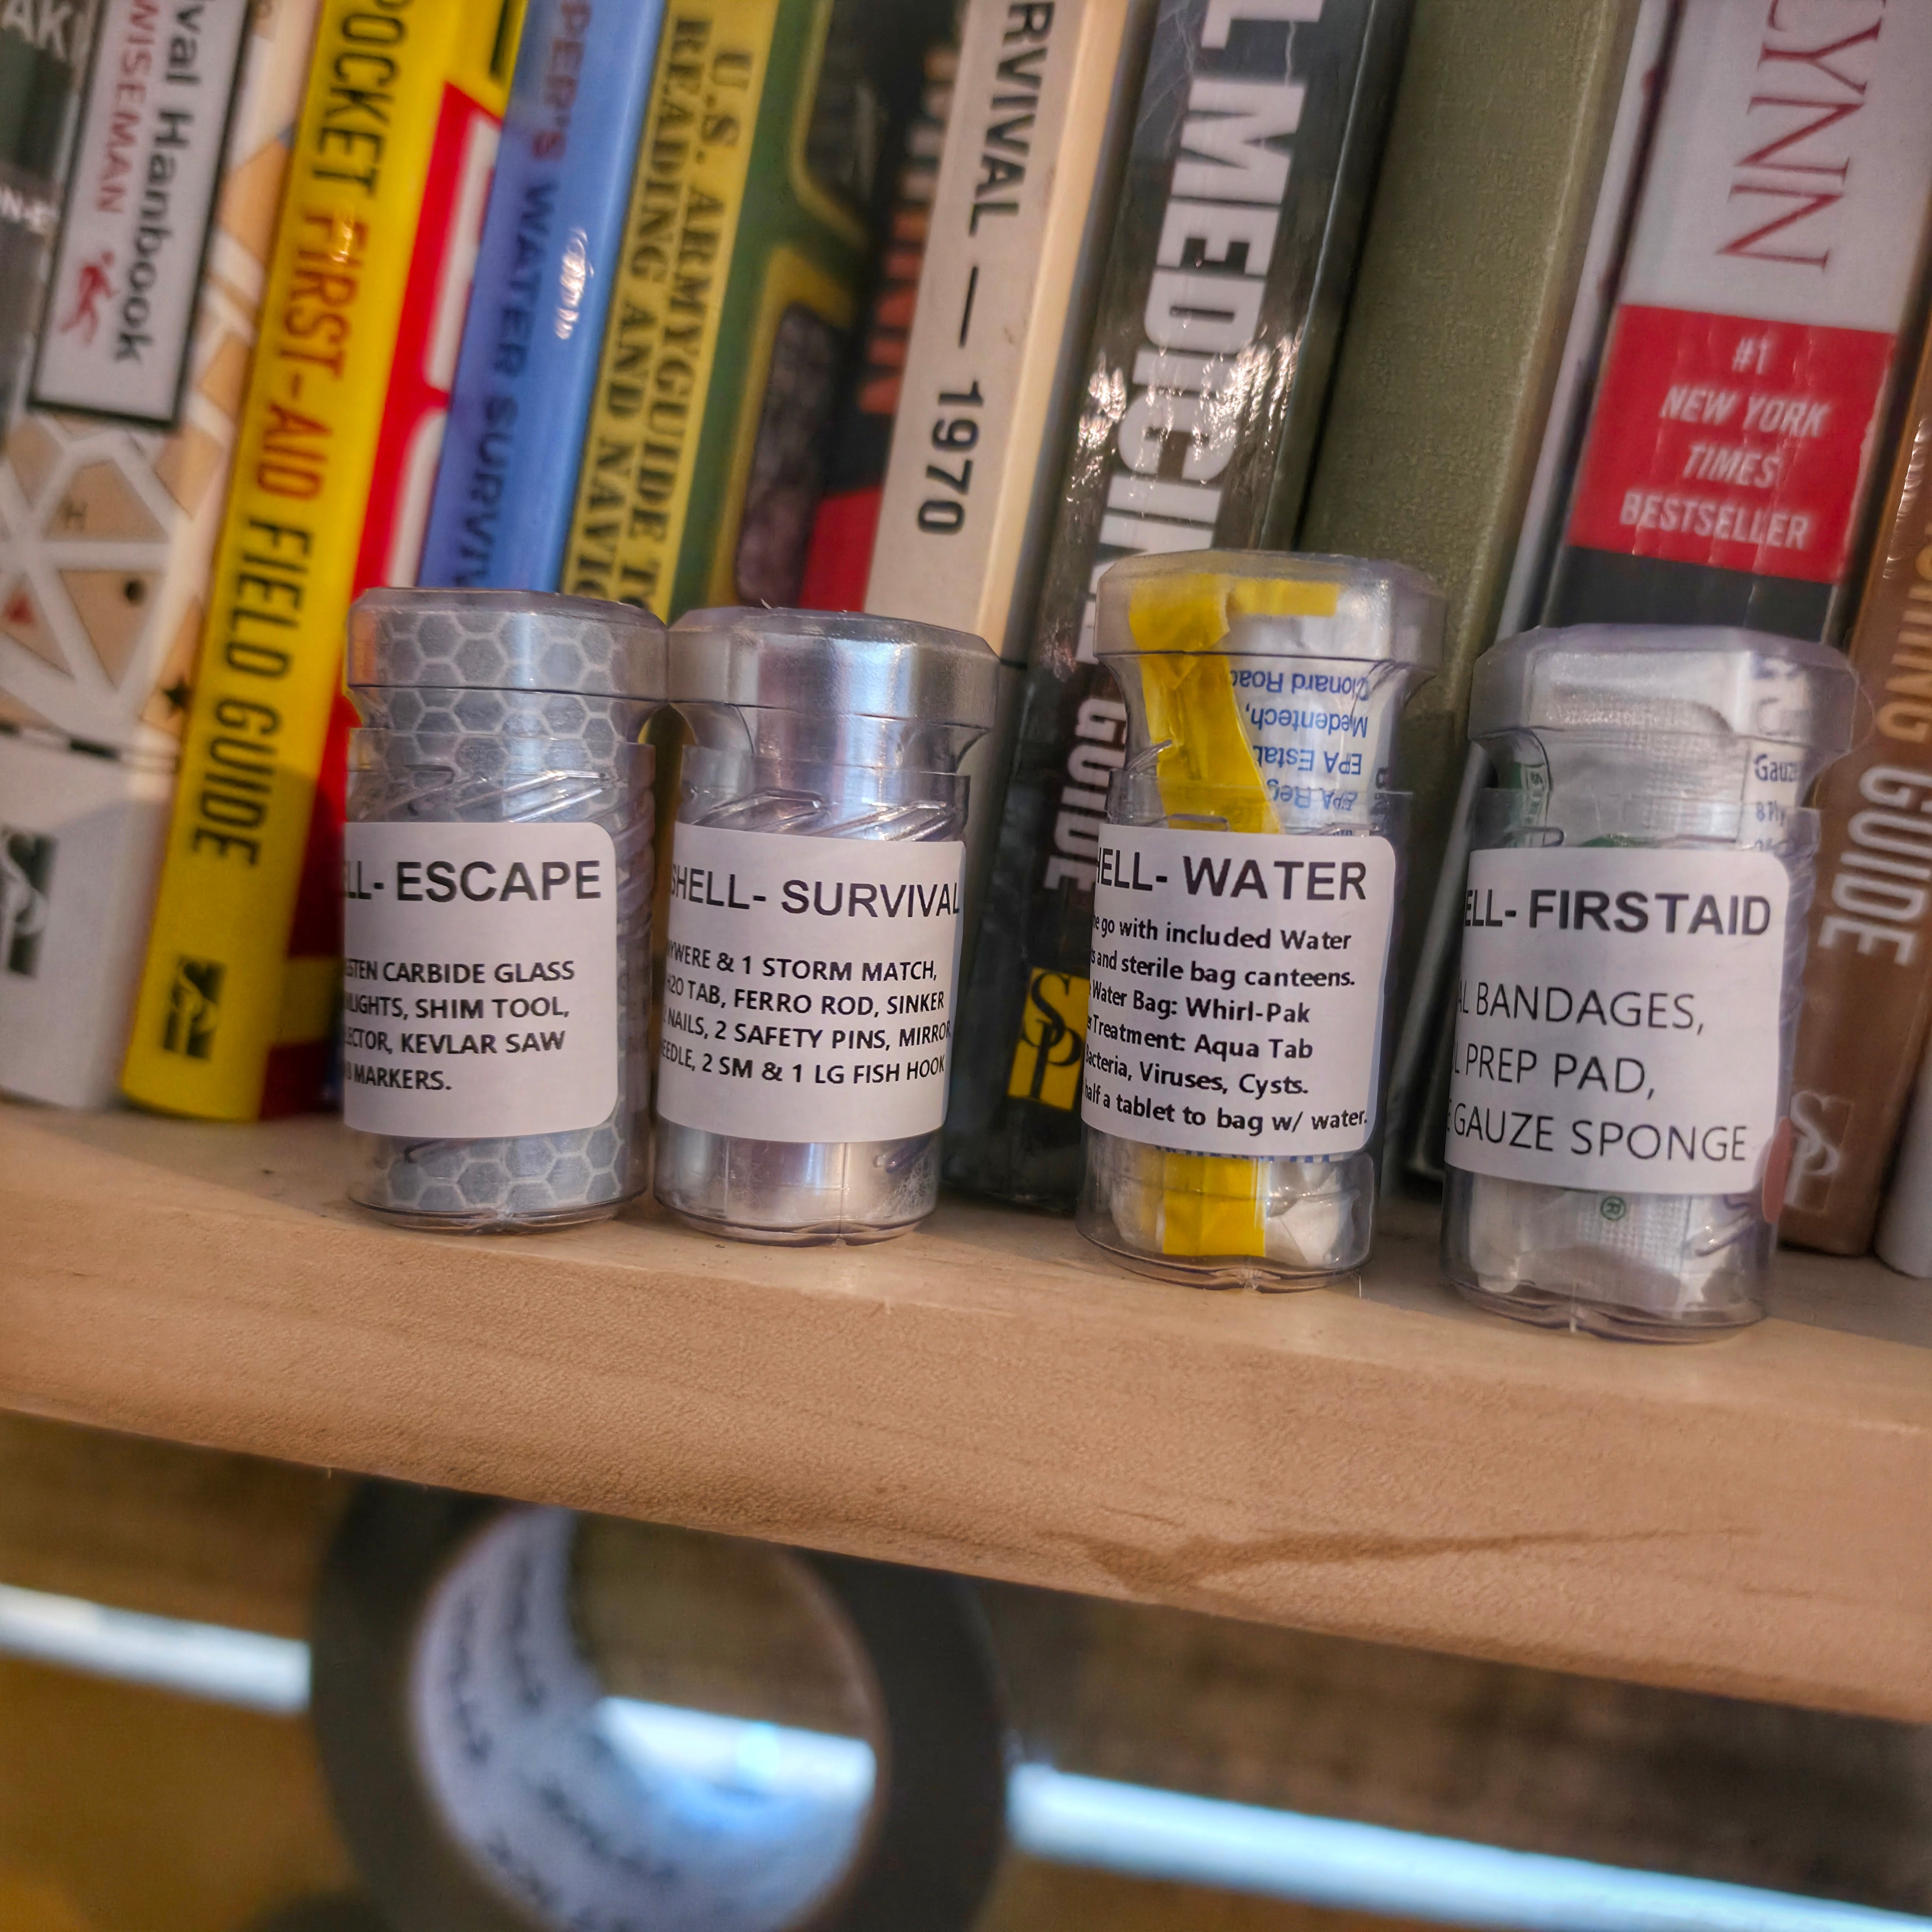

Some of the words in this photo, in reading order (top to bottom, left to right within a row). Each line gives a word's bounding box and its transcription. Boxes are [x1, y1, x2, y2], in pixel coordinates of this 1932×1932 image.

[696, 50, 753, 164] U.S.
[630, 19, 712, 283] READING
[495, 179, 559, 377] WATER
[607, 300, 659, 418] AND
[1732, 337, 1774, 375] #1
[1659, 384, 1741, 425] NEW
[1743, 394, 1833, 439] YORK
[918, 380, 984, 535] 1970
[1682, 442, 1786, 489] TIMES
[1620, 490, 1812, 550] BESTSELLER
[226, 514, 314, 679] FIELD
[1291, 672, 1370, 702] Clonard
[1245, 702, 1369, 738] Medentech,
[193, 697, 282, 867] GUIDE
[1324, 751, 1362, 775] EPA
[397, 861, 601, 903] ESCAPE
[1182, 855, 1366, 900] WATER
[1818, 764, 1932, 967] GUIDE
[781, 879, 960, 918] SURVIVAL
[1101, 918, 1115, 938] go
[1119, 919, 1158, 940] with
[1166, 921, 1271, 949] included
[1280, 930, 1352, 950] Water
[383, 962, 485, 983] CARBIDE
[494, 961, 574, 983] GLASS
[716, 952, 734, 973] &
[742, 956, 751, 975] 1
[762, 957, 852, 981] STORM
[862, 960, 937, 981] MATCH,
[1097, 950, 1117, 970] and
[1121, 956, 1184, 980] sterile
[1190, 960, 1235, 990] bag
[1244, 969, 1355, 987] canteens.
[415, 998, 483, 1019] SHIM
[491, 997, 569, 1019] TOOL,
[688, 980, 726, 1009] TAB,
[734, 988, 811, 1014] FERRO
[821, 995, 879, 1018] ROD,
[887, 991, 944, 1015] SINKER
[1093, 979, 1128, 1007] Water
[1133, 990, 1177, 1020] Bag:
[1185, 997, 1310, 1022] Whirl-Pak
[1476, 981, 1702, 1033] BANDAGES,
[401, 1033, 497, 1054] KEVLAR
[505, 1031, 565, 1053] SAW
[668, 1007, 708, 1039] NAILS,
[714, 1020, 726, 1040] 2
[734, 1023, 823, 1048] SAFETY
[832, 1030, 890, 1051] PINS,
[899, 1020, 951, 1047] MIRROR
[1093, 1014, 1185, 1051] Treatment:
[1194, 1034, 1259, 1062] Aqua
[1268, 1038, 1313, 1058] Tab
[354, 1063, 452, 1090] MARKERS.
[702, 1053, 713, 1073] 2
[719, 1056, 753, 1078] SM
[761, 1061, 783, 1082] &
[793, 1064, 802, 1083] 1
[815, 1065, 844, 1084] LG
[854, 1063, 900, 1084] FISH
[906, 1054, 945, 1080] HOOK
[1085, 1043, 1132, 1081] Bacteria,
[1139, 1061, 1228, 1094] Viruses,
[1239, 1073, 1308, 1100] Cysts.
[1465, 1043, 1537, 1083] PREP
[1554, 1052, 1654, 1099] PAD,
[1085, 1078, 1101, 1105] half
[1103, 1094, 1110, 1109] a
[1116, 1095, 1175, 1122] tablet
[1182, 1106, 1206, 1126] to
[1217, 1107, 1263, 1136] bag
[1272, 1111, 1303, 1133] w/
[1311, 1110, 1368, 1130] water.
[1454, 1102, 1554, 1151] GAUZE
[1570, 1118, 1746, 1161] SPONGE
